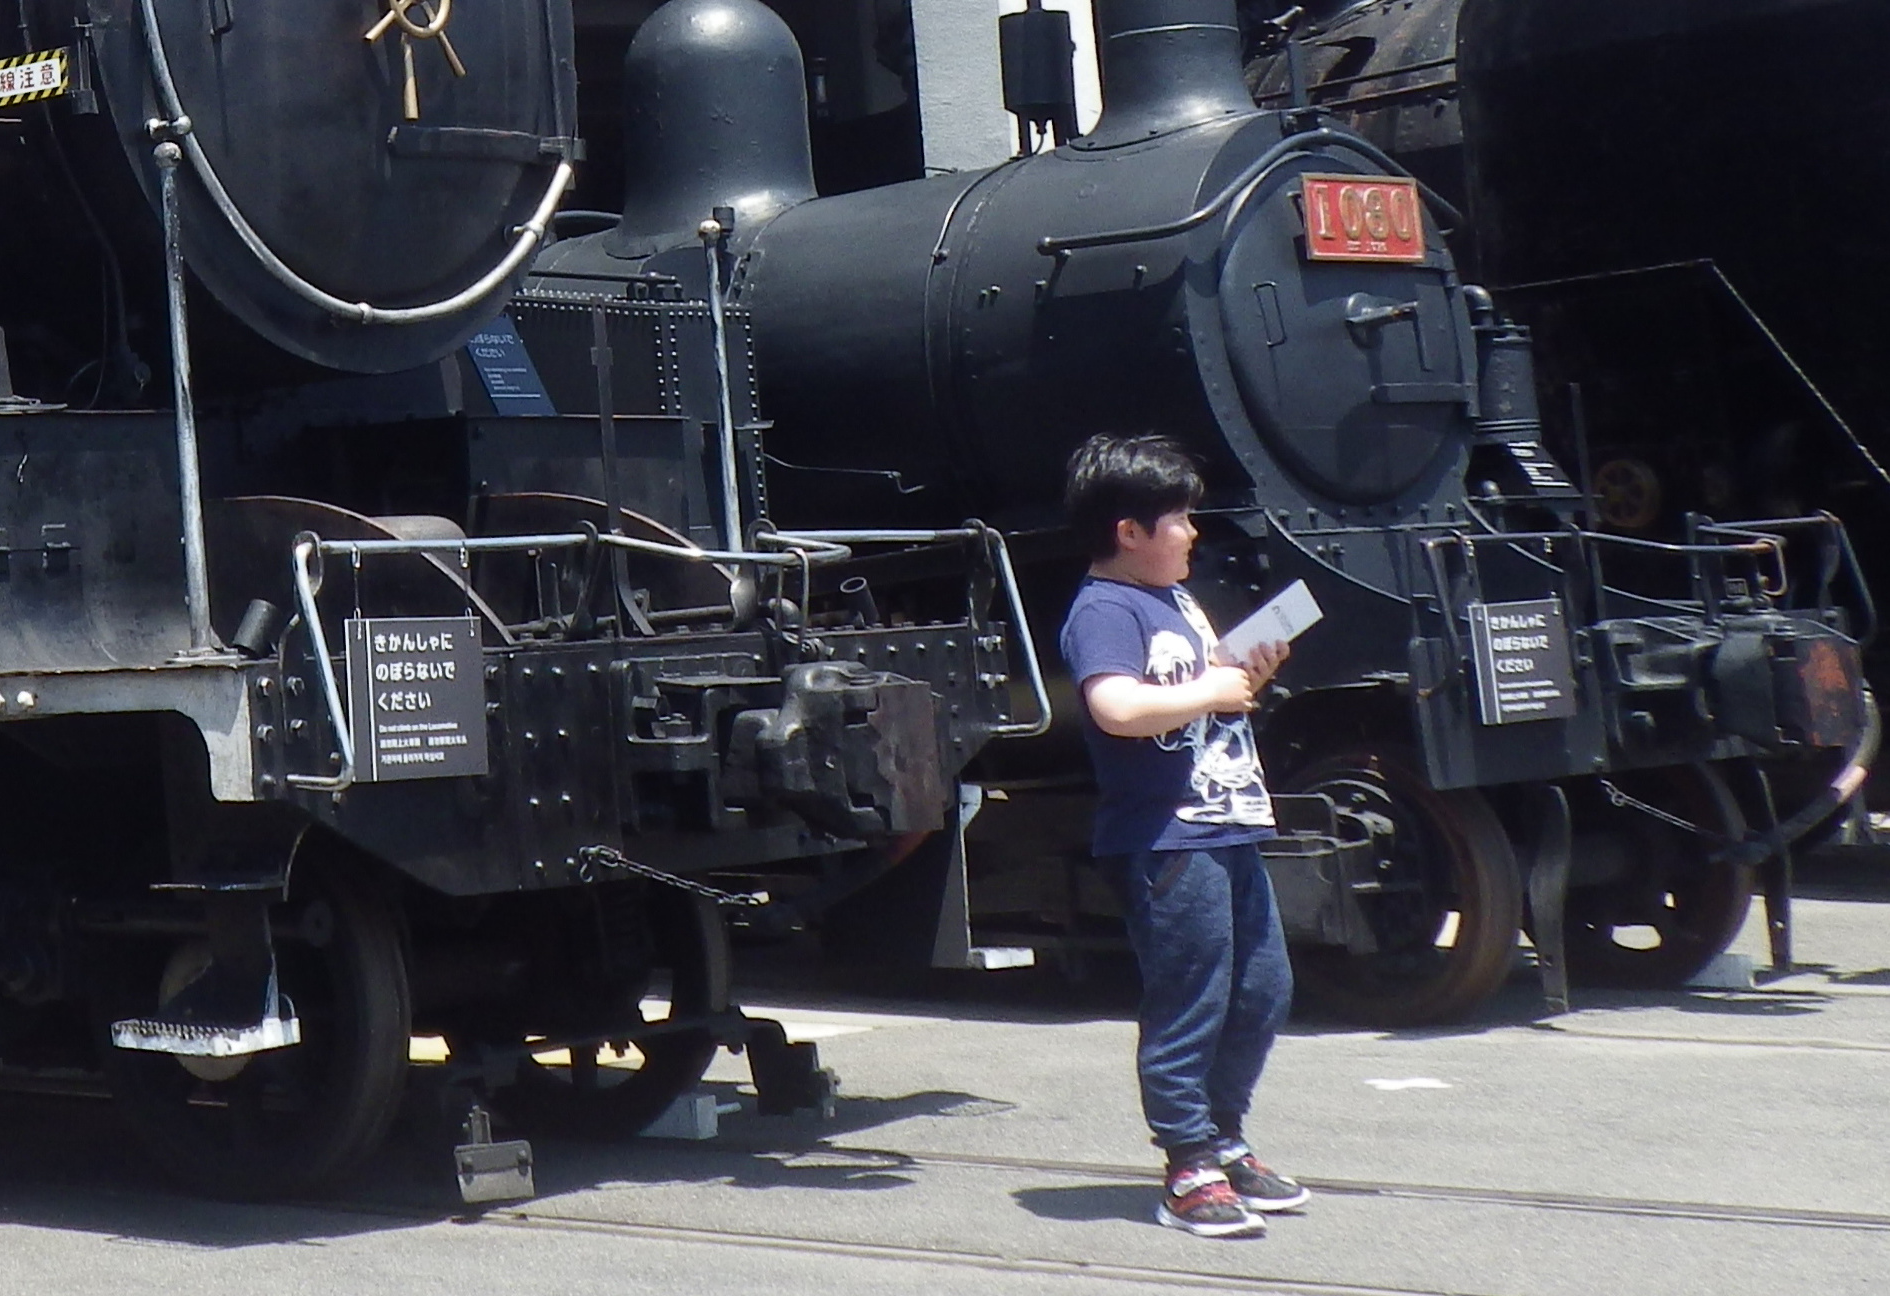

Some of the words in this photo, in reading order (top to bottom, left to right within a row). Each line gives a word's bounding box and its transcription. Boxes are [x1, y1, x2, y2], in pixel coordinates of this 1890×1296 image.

[374, 633, 453, 652] きかんしゃに
[375, 661, 455, 681] のぼらないで
[378, 691, 431, 711] ください
